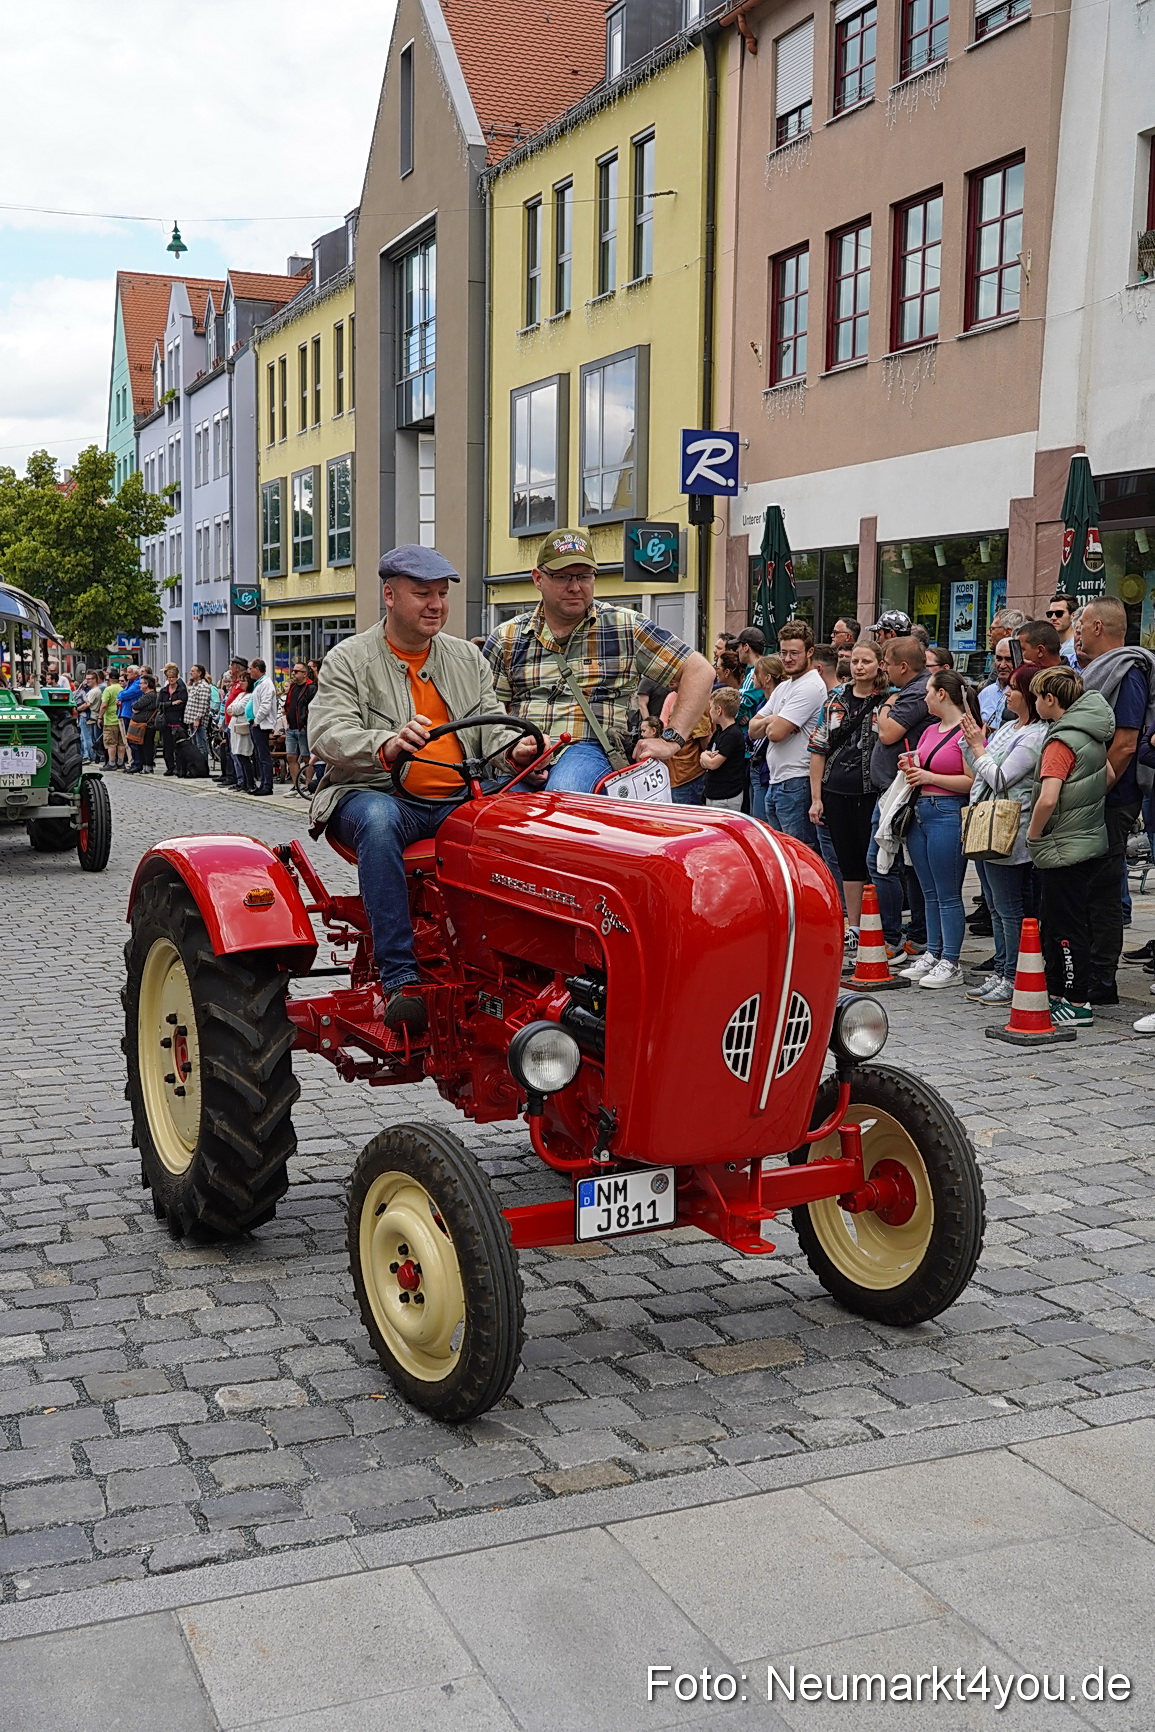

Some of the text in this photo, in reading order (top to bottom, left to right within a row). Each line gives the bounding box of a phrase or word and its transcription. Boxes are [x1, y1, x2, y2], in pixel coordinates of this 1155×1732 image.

[742, 514, 762, 526] Unterer
[646, 538, 666, 563] G2
[241, 592, 253, 605] G2
[956, 584, 974, 593] KOBR
[643, 768, 664, 792] 155
[597, 1179, 628, 1207] NM
[597, 1199, 660, 1233] J811
